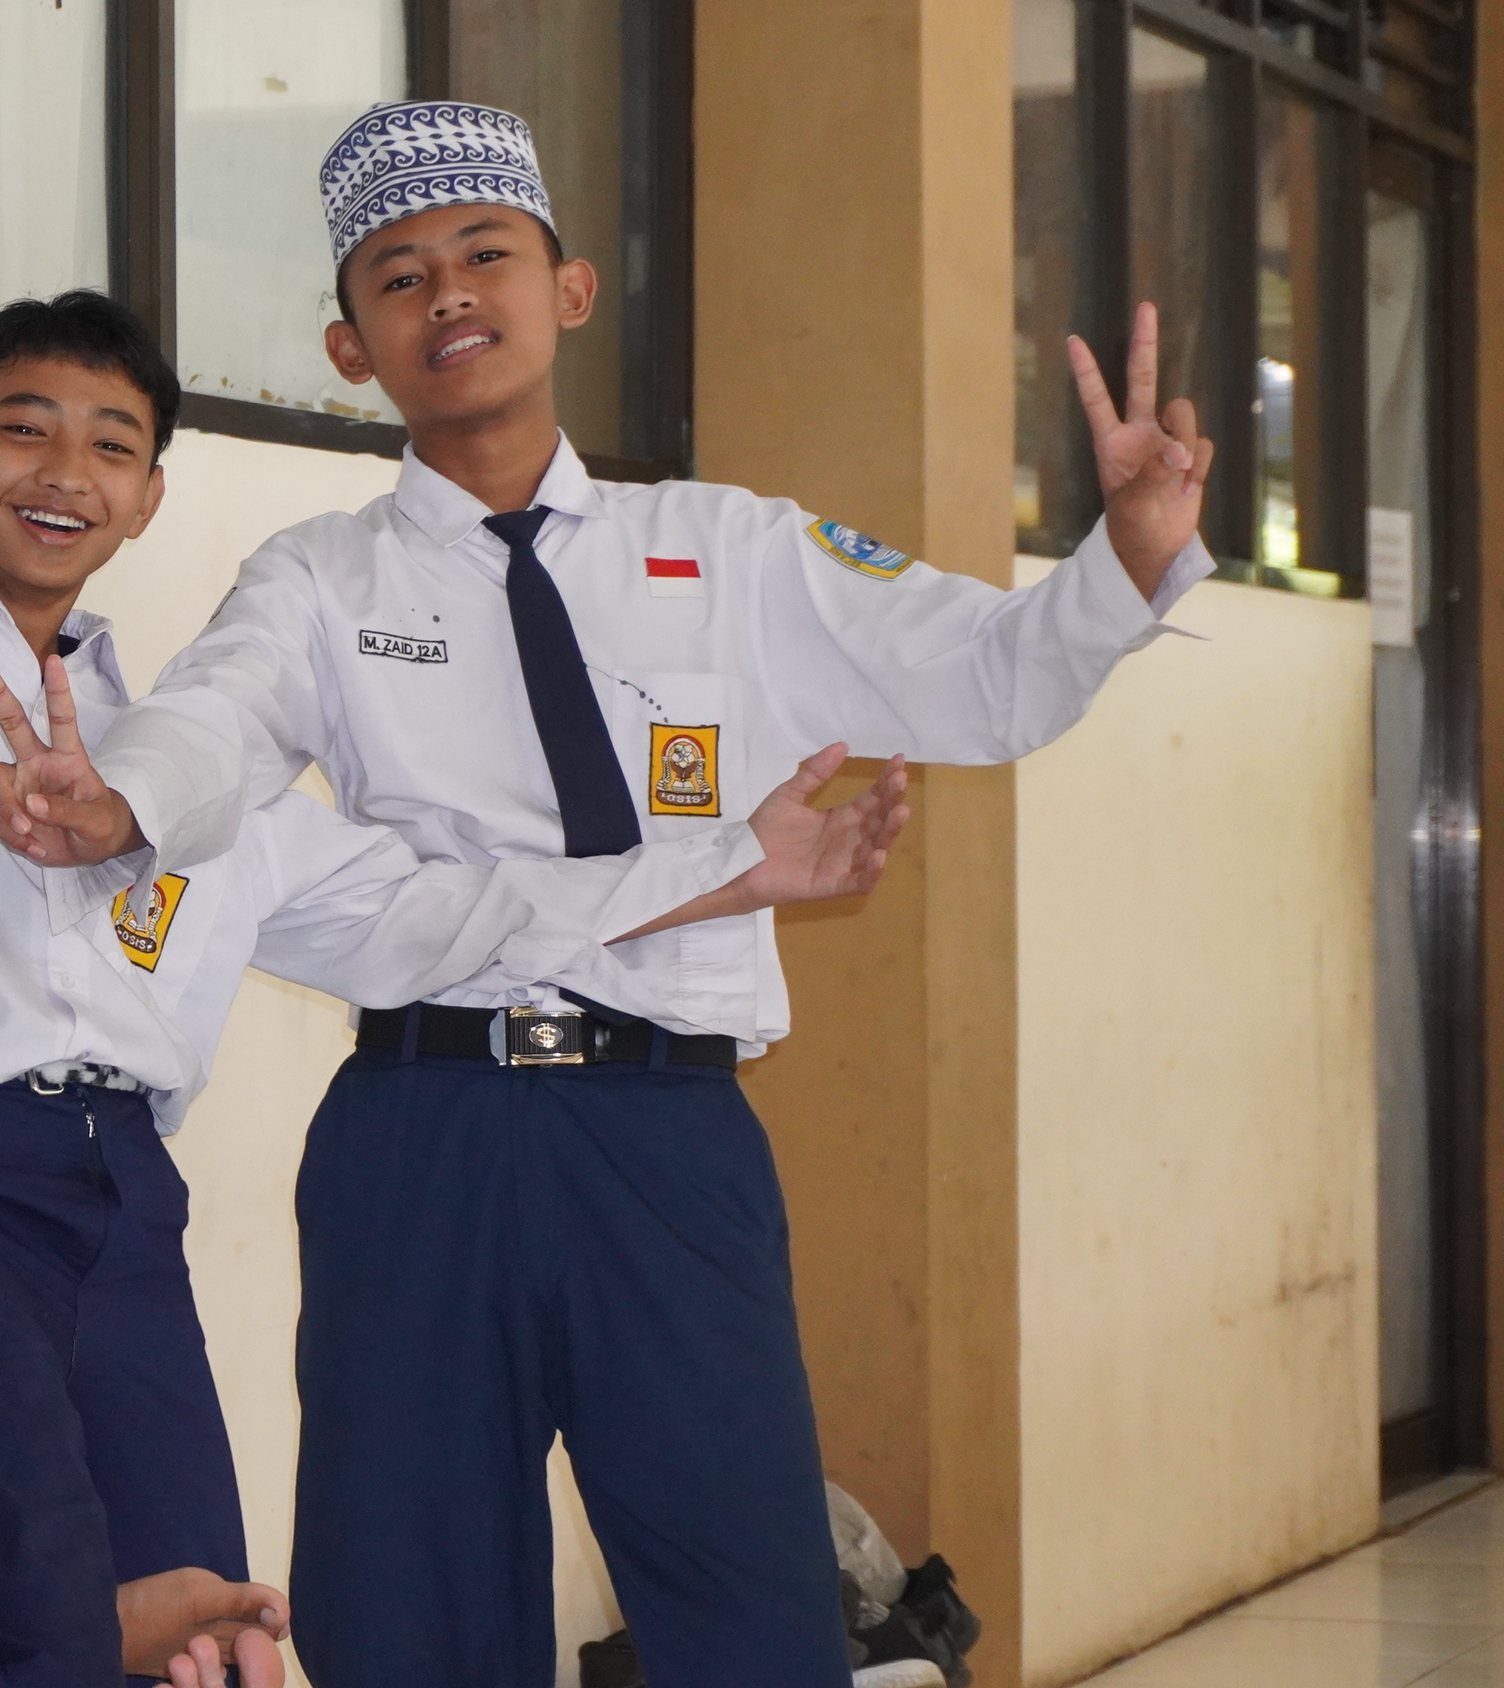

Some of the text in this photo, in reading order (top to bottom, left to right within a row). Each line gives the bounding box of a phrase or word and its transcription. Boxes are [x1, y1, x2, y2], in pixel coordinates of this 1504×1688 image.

[363, 635, 442, 658] M. ZAID 12A
[122, 931, 146, 950] OSIS
